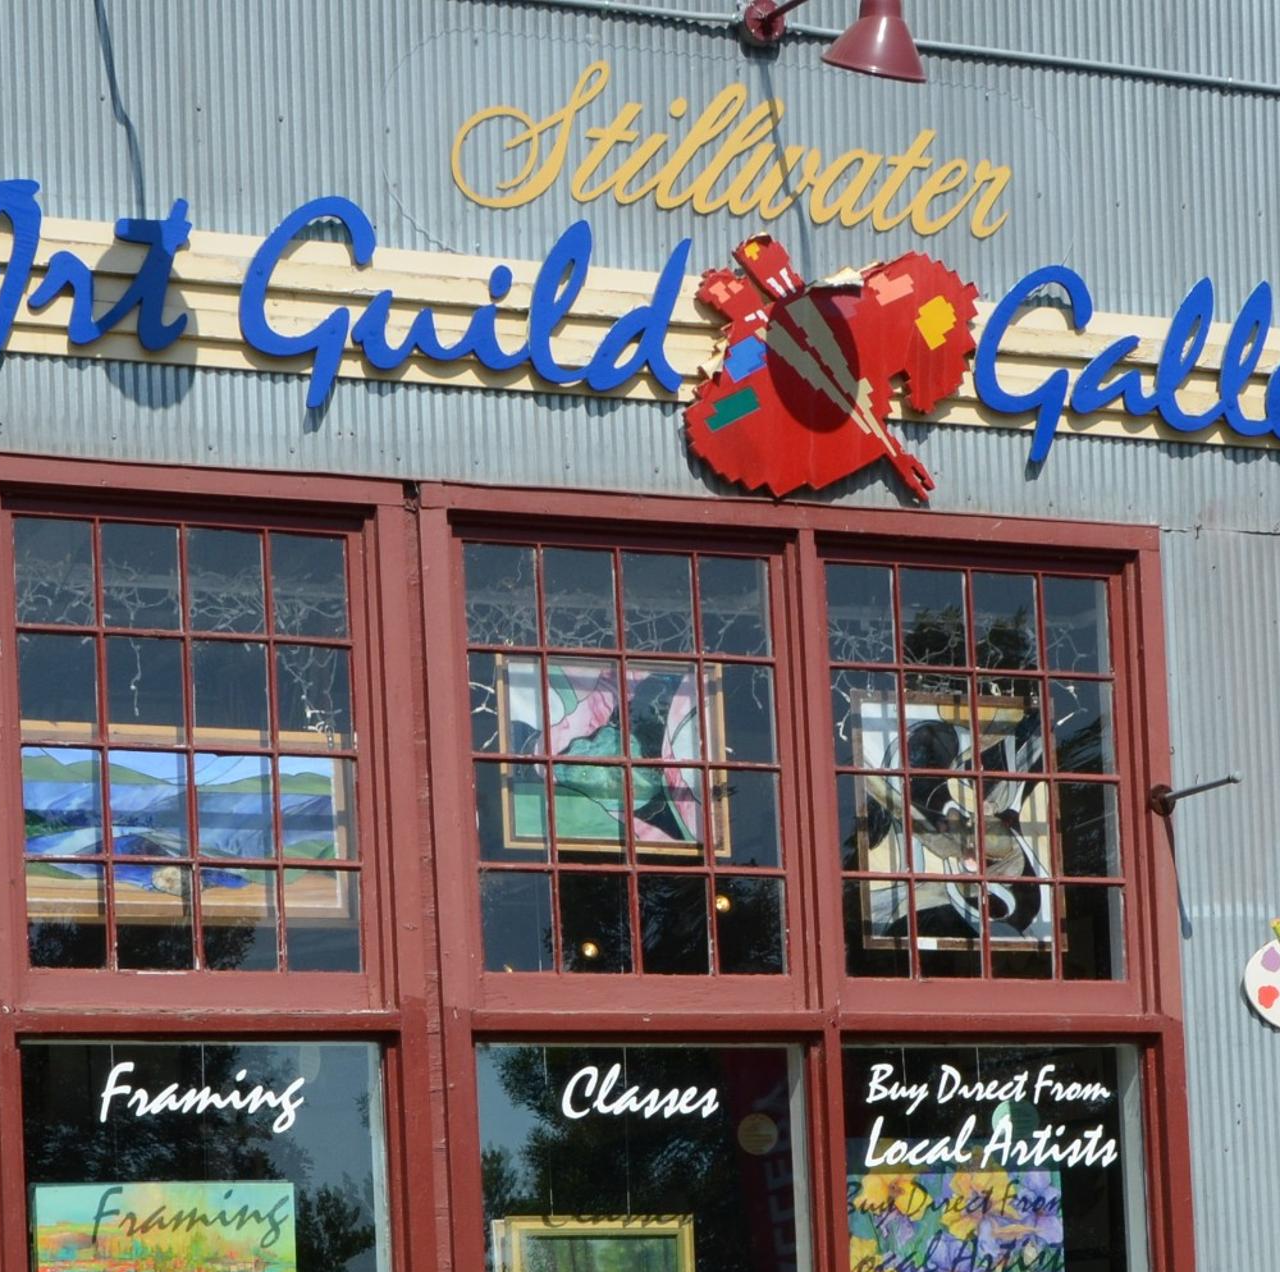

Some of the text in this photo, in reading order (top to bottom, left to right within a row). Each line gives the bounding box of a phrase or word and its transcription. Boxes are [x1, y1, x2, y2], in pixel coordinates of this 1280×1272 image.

[451, 60, 1010, 238] Stillwater
[239, 195, 692, 411] Guild
[100, 1062, 305, 1133] Framing
[561, 1063, 719, 1120] Classes
[865, 1063, 1111, 1115] Buy Direct From
[865, 1113, 1118, 1169] Local Artists
